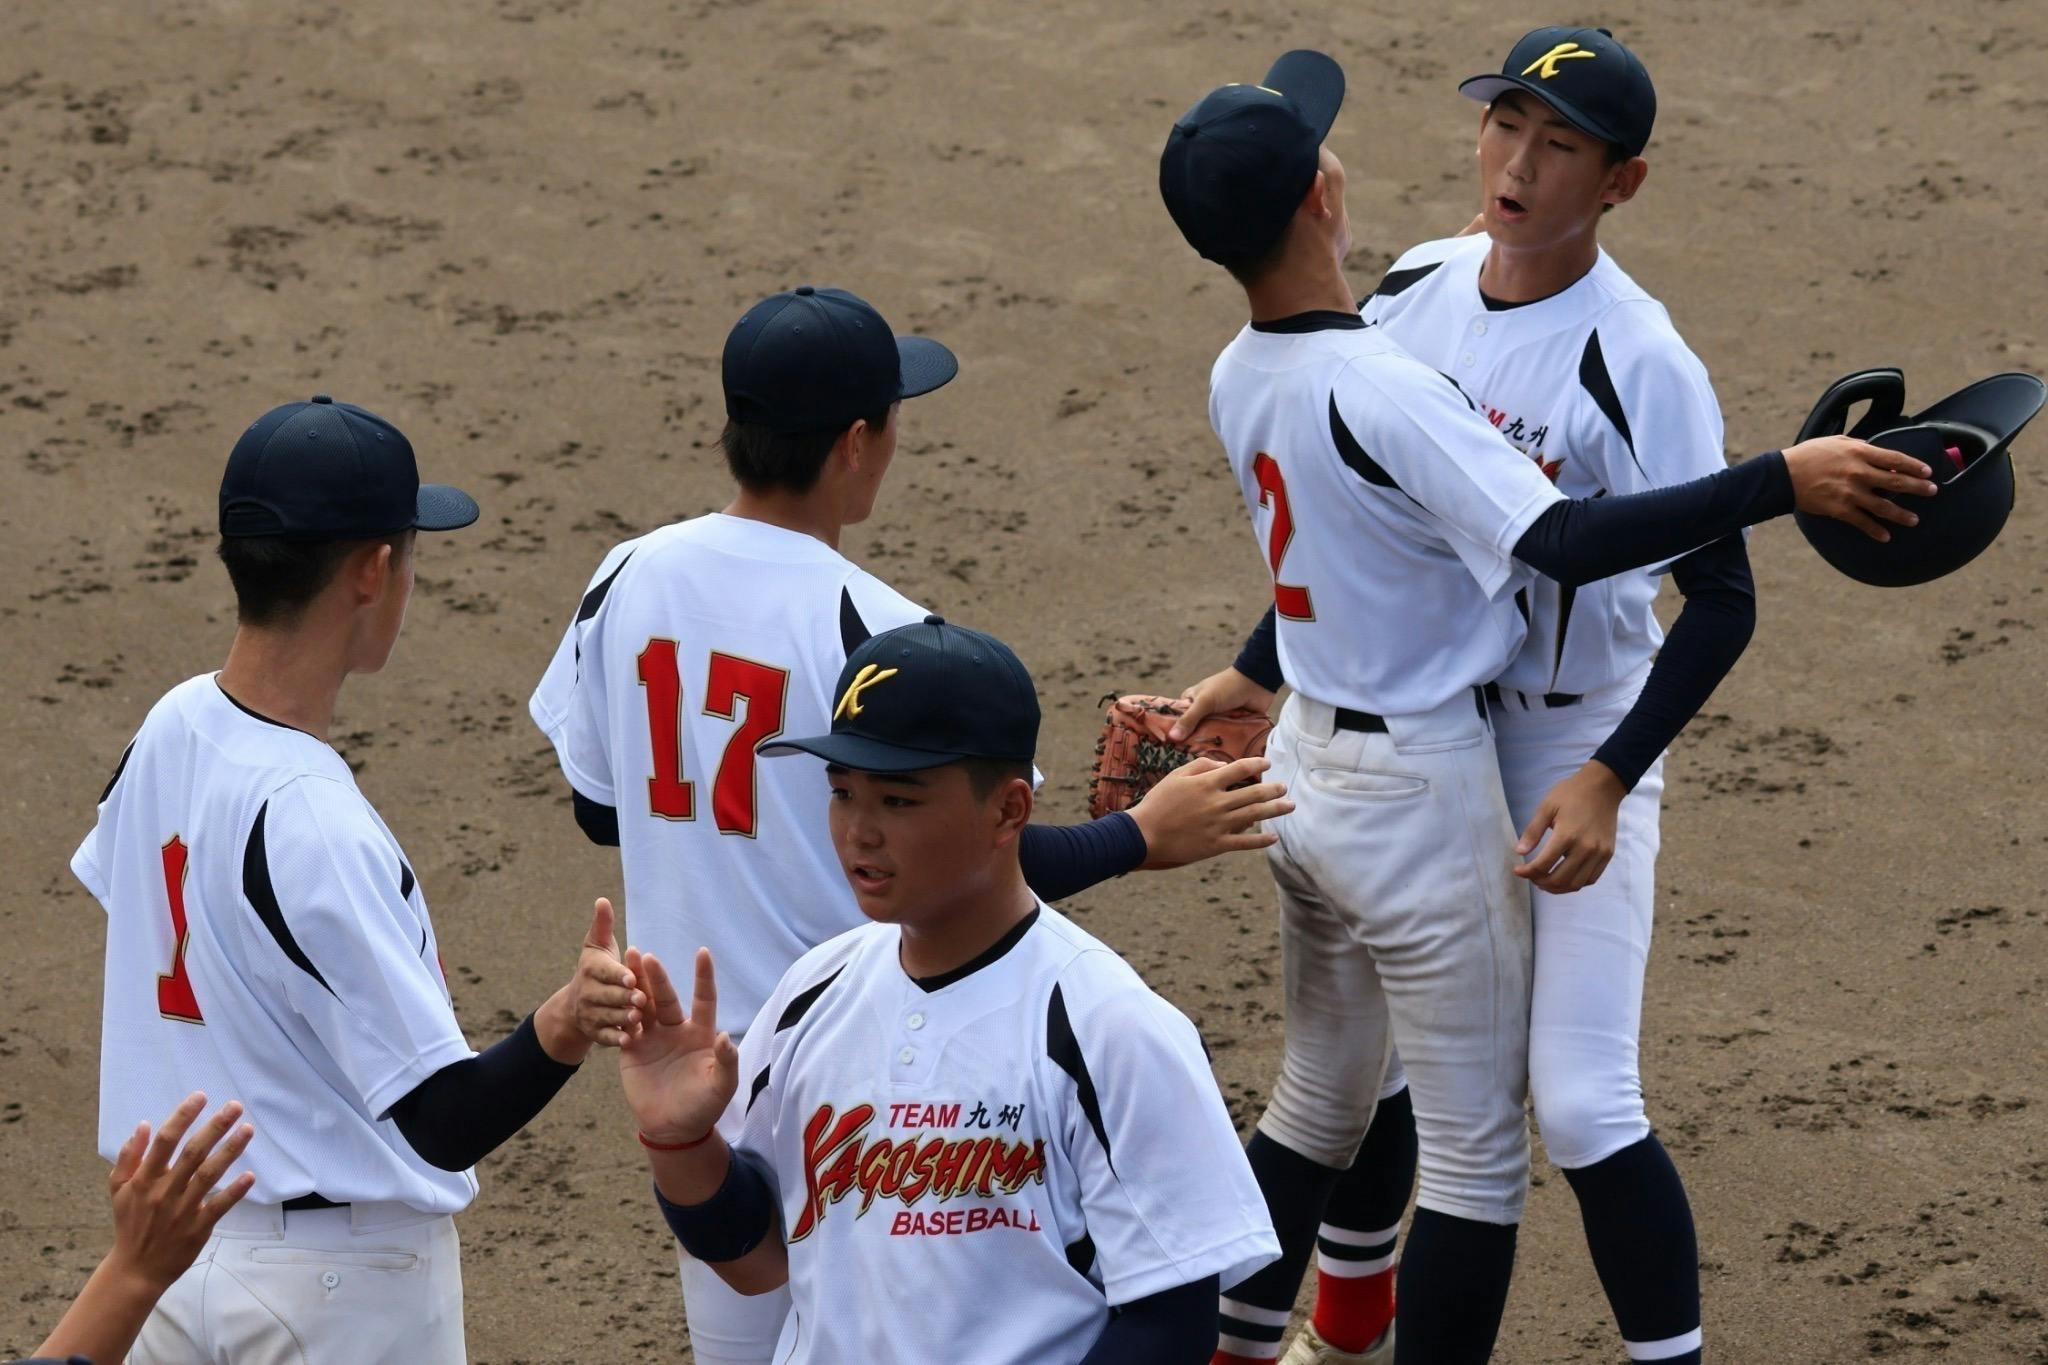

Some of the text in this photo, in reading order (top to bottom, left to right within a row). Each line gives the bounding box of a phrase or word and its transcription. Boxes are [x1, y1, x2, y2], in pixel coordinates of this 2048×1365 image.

[1521, 42, 1596, 79] K
[1252, 452, 1316, 622] 2
[636, 636, 790, 839] 17
[833, 663, 898, 720] K
[156, 831, 206, 1026] 1
[889, 1101, 1025, 1132] TEAM 九州
[787, 1103, 1047, 1244] KAGOSHIMA
[890, 1207, 1041, 1236] BASEBALL
